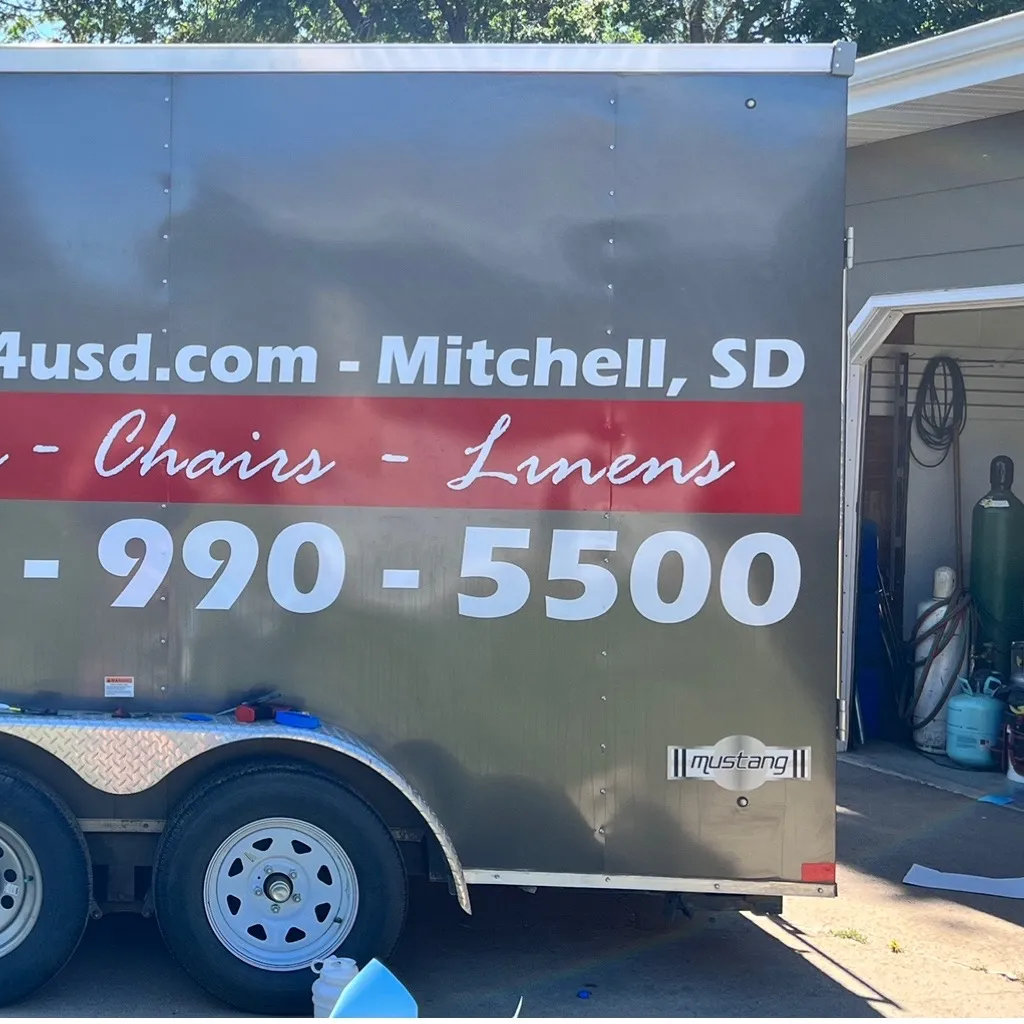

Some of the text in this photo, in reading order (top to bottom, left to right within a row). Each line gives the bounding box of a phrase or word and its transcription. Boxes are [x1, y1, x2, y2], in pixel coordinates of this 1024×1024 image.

[339, 361, 360, 373] -
[377, 335, 687, 397] Mitchell,
[709, 338, 805, 388] SD
[32, 444, 60, 453] -
[94, 408, 336, 485] Chairs
[381, 453, 409, 462] -
[447, 414, 735, 490] Linens
[23, 559, 60, 578] -
[97, 518, 345, 613] 990
[382, 569, 420, 588] -
[457, 526, 801, 626] 5500
[690, 751, 789, 775] mustang
